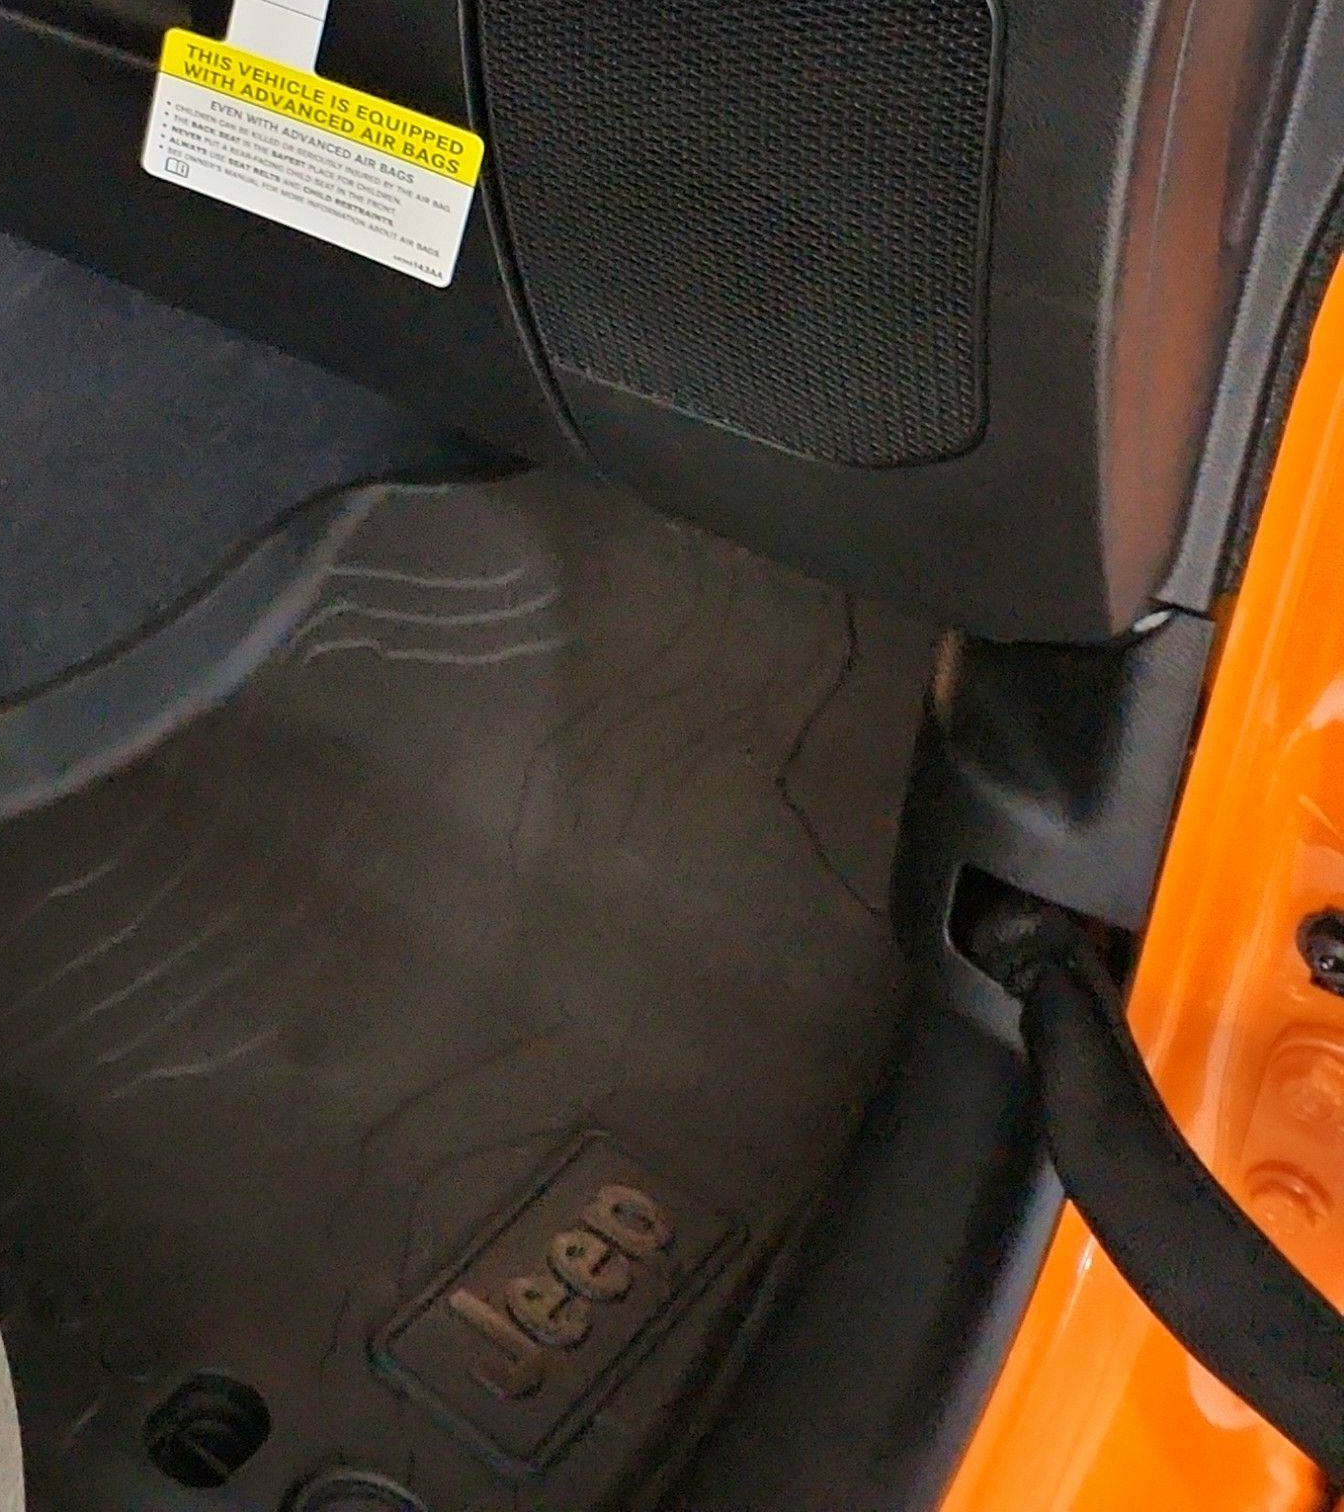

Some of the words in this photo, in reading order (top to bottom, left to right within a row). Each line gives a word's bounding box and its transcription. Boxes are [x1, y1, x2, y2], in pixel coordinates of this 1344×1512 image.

[183, 62, 234, 90] WITH
[240, 82, 354, 134] ADVANCED
[360, 125, 396, 150] AIR
[403, 141, 459, 174] BAGS
[186, 44, 231, 71] THIS
[237, 62, 324, 104] VEHICLE
[330, 95, 349, 113] IS
[356, 105, 464, 156] EQUIPPED
[170, 136, 206, 154] ALWAYS
[228, 158, 249, 170] SEAT
[253, 168, 279, 181] BELTS
[283, 179, 300, 189] AND
[303, 186, 331, 201] CHILD
[172, 126, 200, 140] NEVER
[287, 168, 310, 181] CHILD
[314, 179, 333, 190] SEAT
[348, 192, 364, 202] THE
[174, 115, 187, 124] THE
[191, 121, 213, 133] BACK
[219, 131, 239, 143] SEAT
[253, 144, 267, 153] THE
[272, 151, 304, 167] SAFEST
[308, 164, 333, 178] PLACE
[337, 175, 353, 186] FOR
[176, 104, 215, 123] CHILDREN
[219, 120, 234, 130] CAN
[251, 132, 278, 146] KILLED
[282, 143, 293, 151] OR
[297, 148, 340, 169] SERIOUSLY
[383, 181, 393, 189] BY
[396, 186, 412, 197] THE
[415, 194, 429, 204] AIR
[210, 101, 241, 119] EVEN
[246, 114, 277, 132] WITH
[282, 127, 350, 159] ADVANCED
[354, 154, 375, 168] AIR
[379, 163, 414, 183] BAGS
[262, 182, 276, 192] FOR
[280, 189, 303, 202] MORE
[369, 223, 396, 239] ABOUT
[399, 236, 413, 246] AIR
[448, 1185, 676, 1398] Jeep
